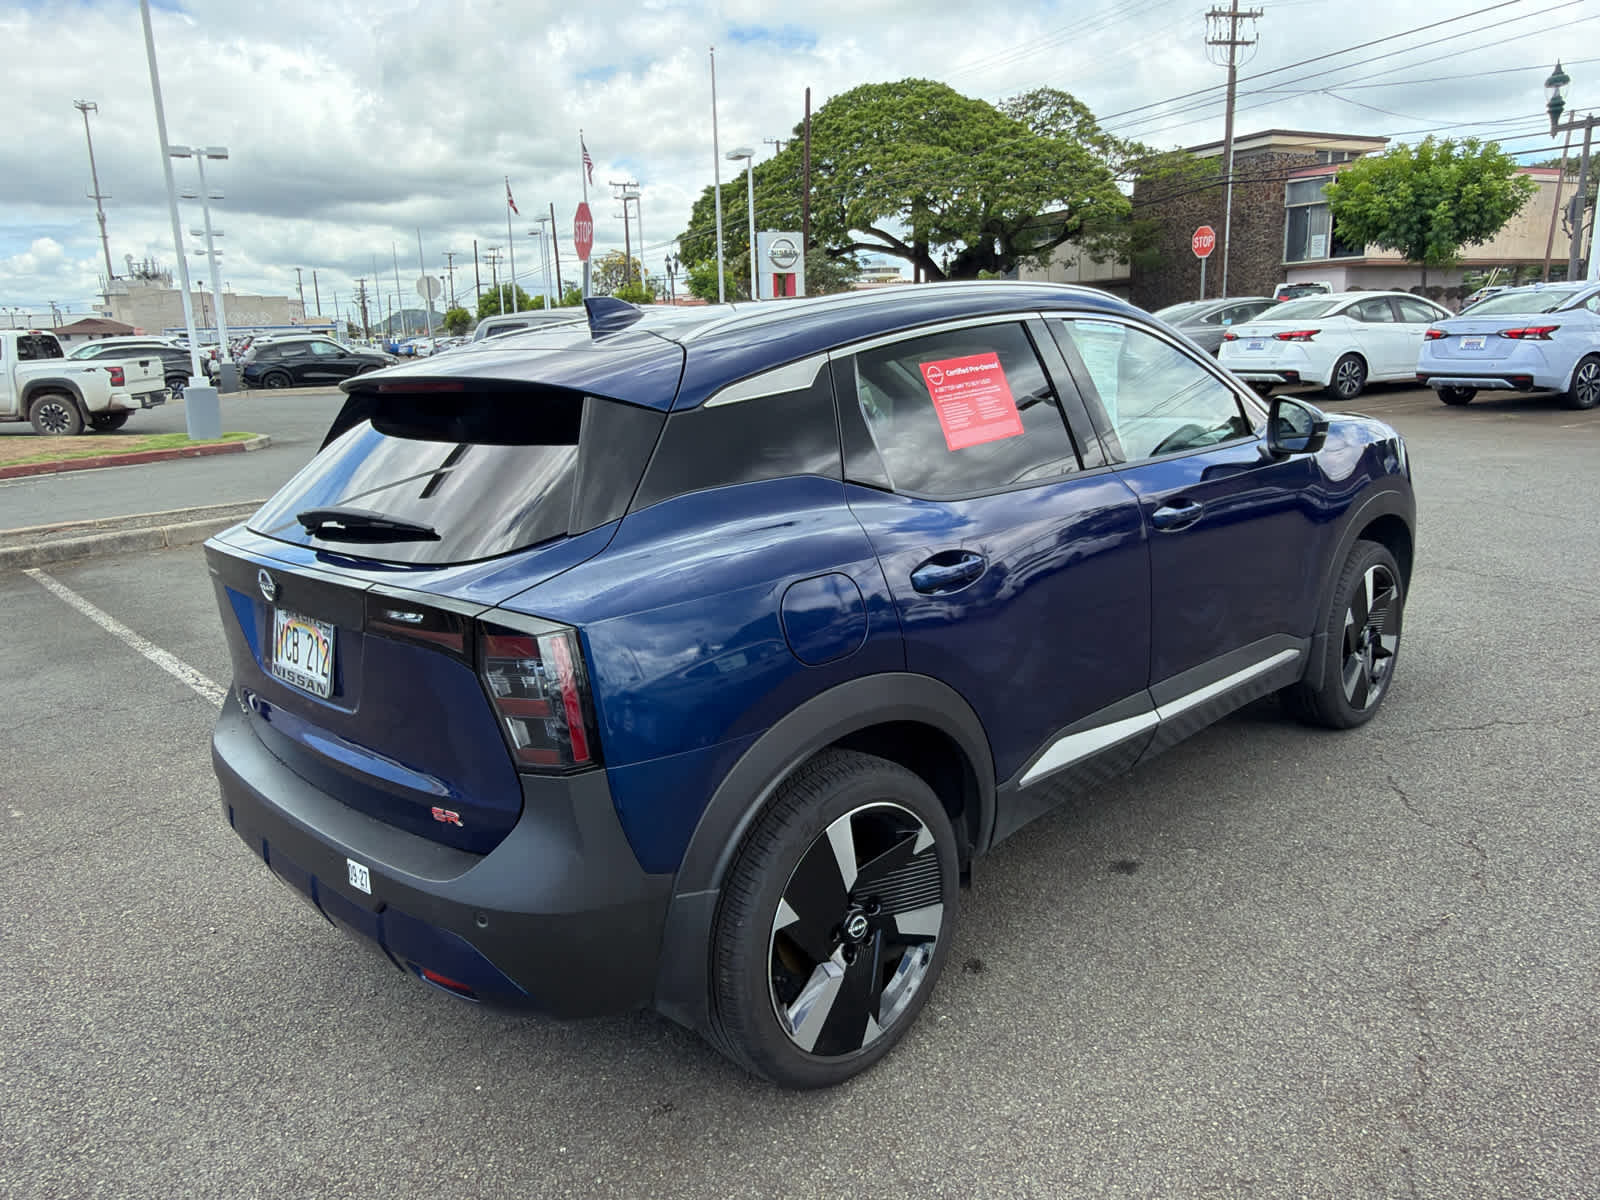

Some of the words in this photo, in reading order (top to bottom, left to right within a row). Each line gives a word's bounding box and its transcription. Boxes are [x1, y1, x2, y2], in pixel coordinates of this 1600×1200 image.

[574, 221, 592, 243] STOP
[1194, 235, 1213, 249] STOP
[307, 633, 329, 678] 212
[273, 664, 327, 697] NISSAN
[431, 806, 464, 827] SR
